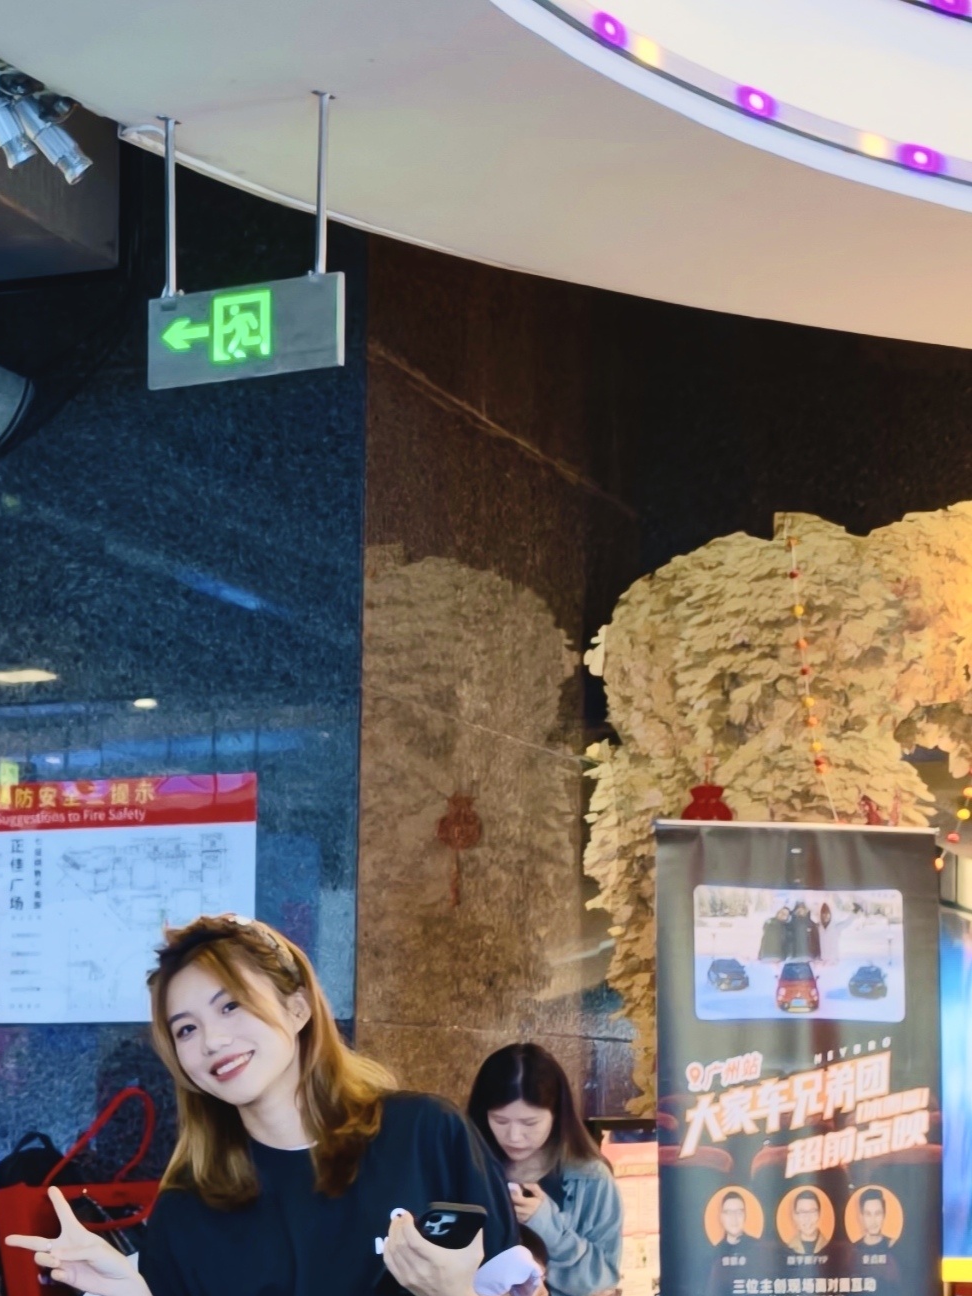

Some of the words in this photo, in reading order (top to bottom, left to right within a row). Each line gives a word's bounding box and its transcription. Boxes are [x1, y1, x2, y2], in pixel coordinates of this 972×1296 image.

[68, 811, 81, 823] to
[83, 809, 105, 822] Fire
[108, 807, 147, 823] Safety
[10, 838, 24, 911] 正佳广场
[680, 1051, 892, 1159] 大家车兄弟团
[702, 1051, 763, 1091] 广州站
[785, 1110, 930, 1178] 超前点映
